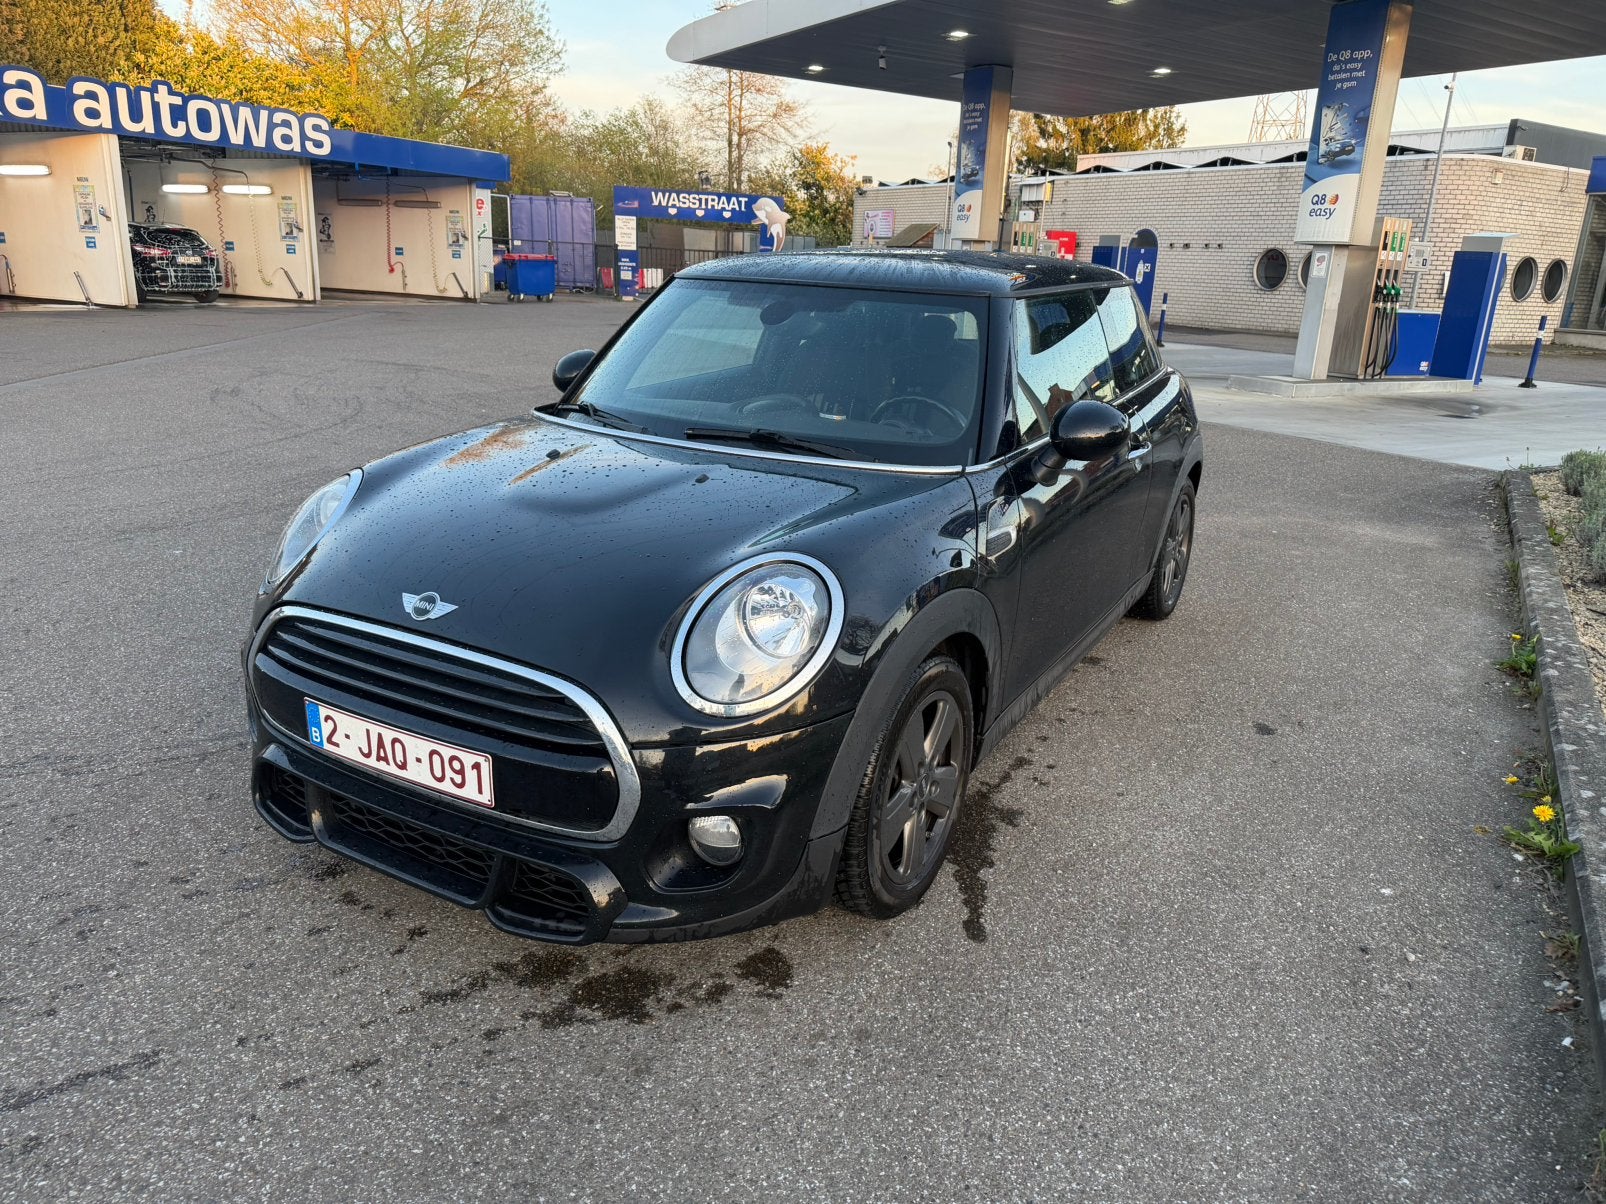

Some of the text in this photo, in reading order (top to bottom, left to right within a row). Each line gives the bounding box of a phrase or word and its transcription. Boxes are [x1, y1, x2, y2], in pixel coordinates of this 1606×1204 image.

[1328, 49, 1373, 62] De Q8 app,
[1346, 62, 1362, 70] easy
[1328, 70, 1366, 81] betalen met
[1334, 80, 1357, 91] je gsm
[73, 81, 332, 156] autowas
[651, 191, 748, 212] WASSTRAAT
[1311, 193, 1327, 206] Q8
[957, 203, 965, 213] Q8
[1309, 207, 1337, 220] easy
[956, 214, 970, 224] easy
[415, 600, 435, 611] MINI
[312, 727, 321, 742] B
[324, 714, 484, 795] 2-JAQ-091
